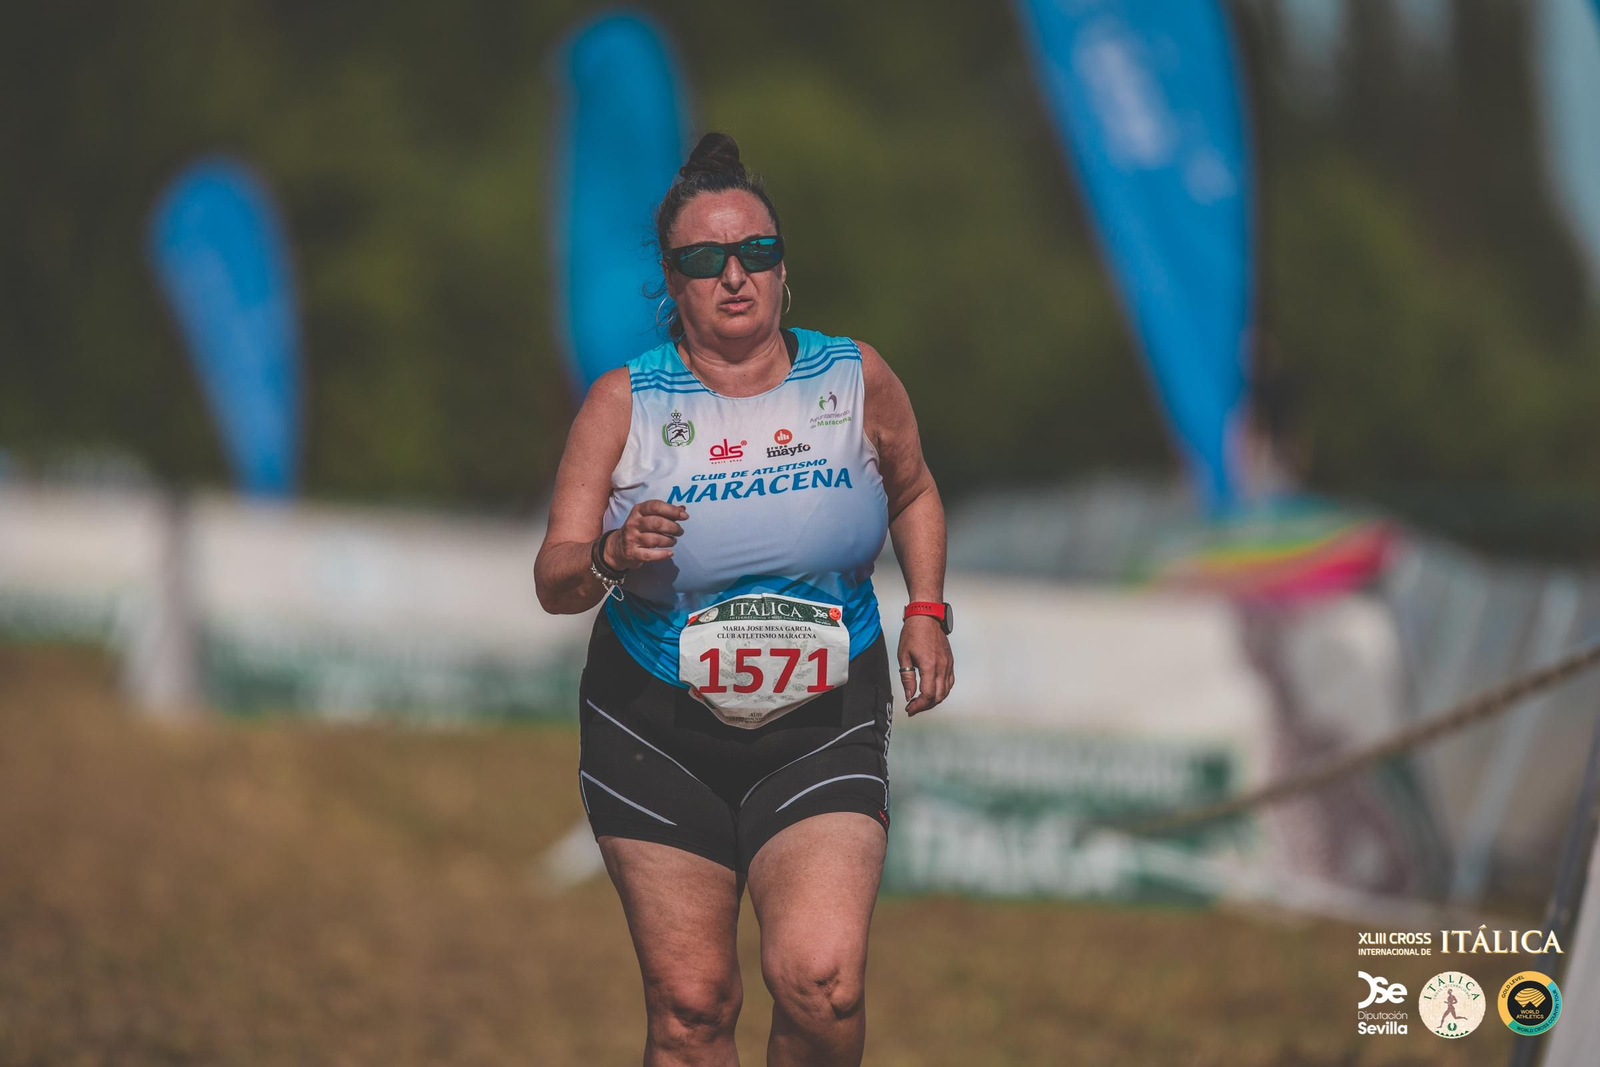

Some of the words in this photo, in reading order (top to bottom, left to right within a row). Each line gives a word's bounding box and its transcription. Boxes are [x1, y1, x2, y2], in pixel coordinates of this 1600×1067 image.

[810, 410, 850, 423] Ayuntamiento
[817, 416, 852, 426] Maracena
[767, 443, 811, 458] mayfo
[691, 472, 726, 482] CLUB
[731, 470, 749, 478] DE
[752, 458, 828, 475] ATLETISMO
[667, 467, 853, 504] MARACENA
[730, 600, 803, 618] ITÁLICA
[698, 648, 834, 694] 1571
